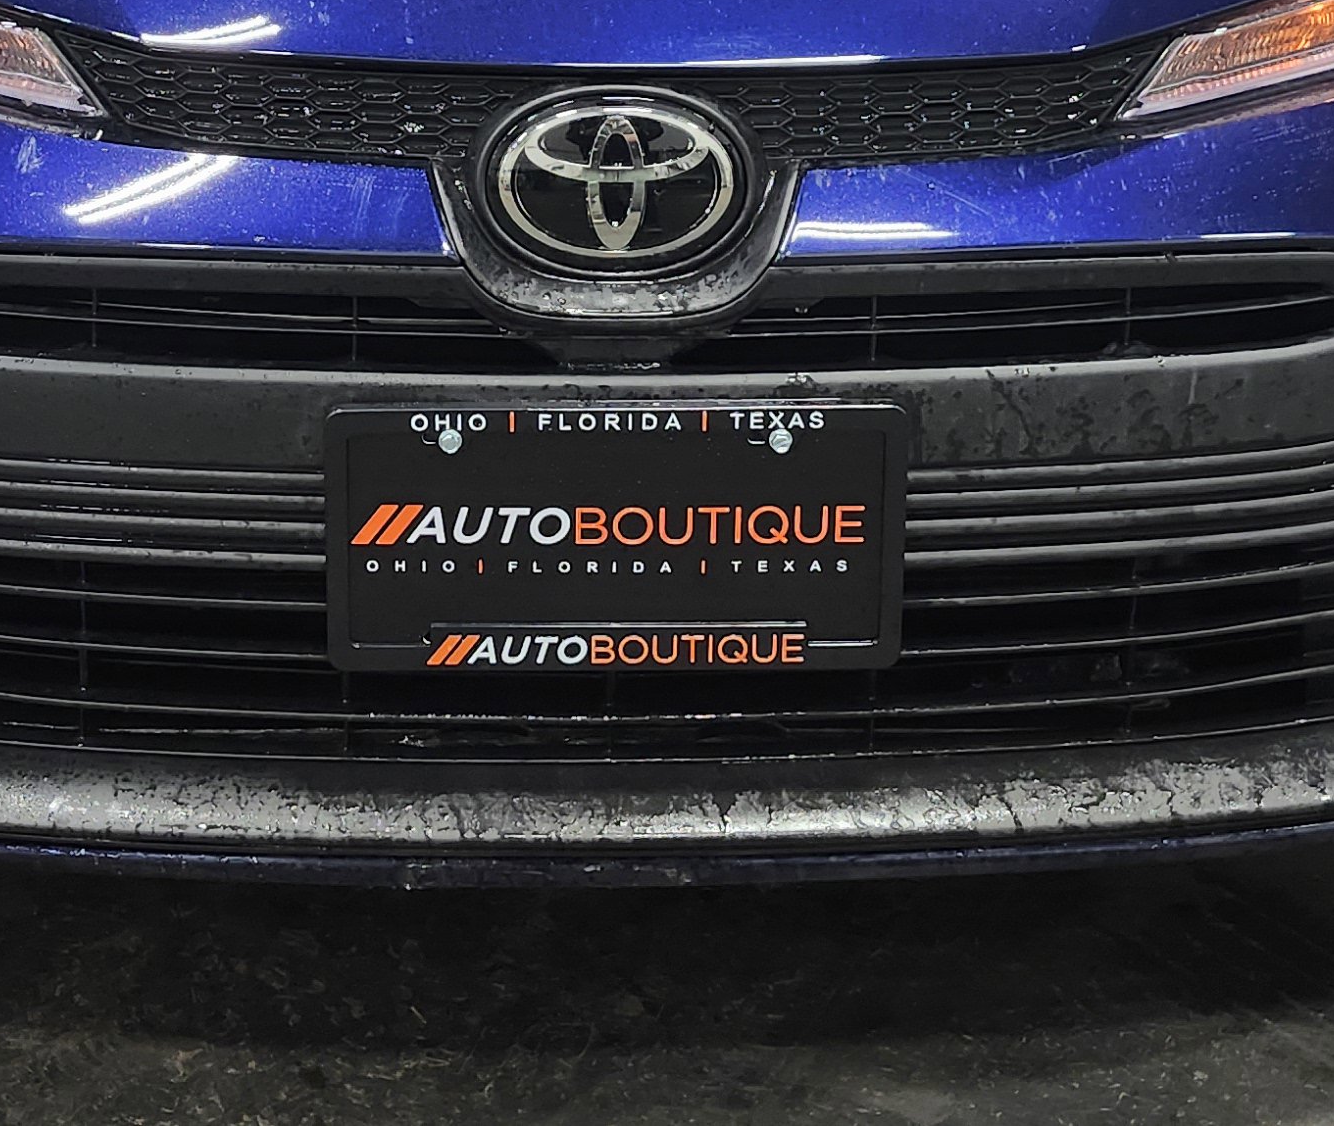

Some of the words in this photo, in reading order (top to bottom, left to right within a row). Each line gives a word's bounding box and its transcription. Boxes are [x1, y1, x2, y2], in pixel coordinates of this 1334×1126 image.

[410, 413, 487, 431] OHIO
[538, 412, 682, 432] FLORIDA
[730, 411, 825, 430] TEXAS
[406, 504, 866, 545] AUTOBOUTIQUE
[366, 560, 456, 573] OHIO
[508, 560, 672, 574] FLORIDA
[731, 559, 848, 573] TEXAS
[467, 634, 805, 665] AUTOBOUTIQUE
